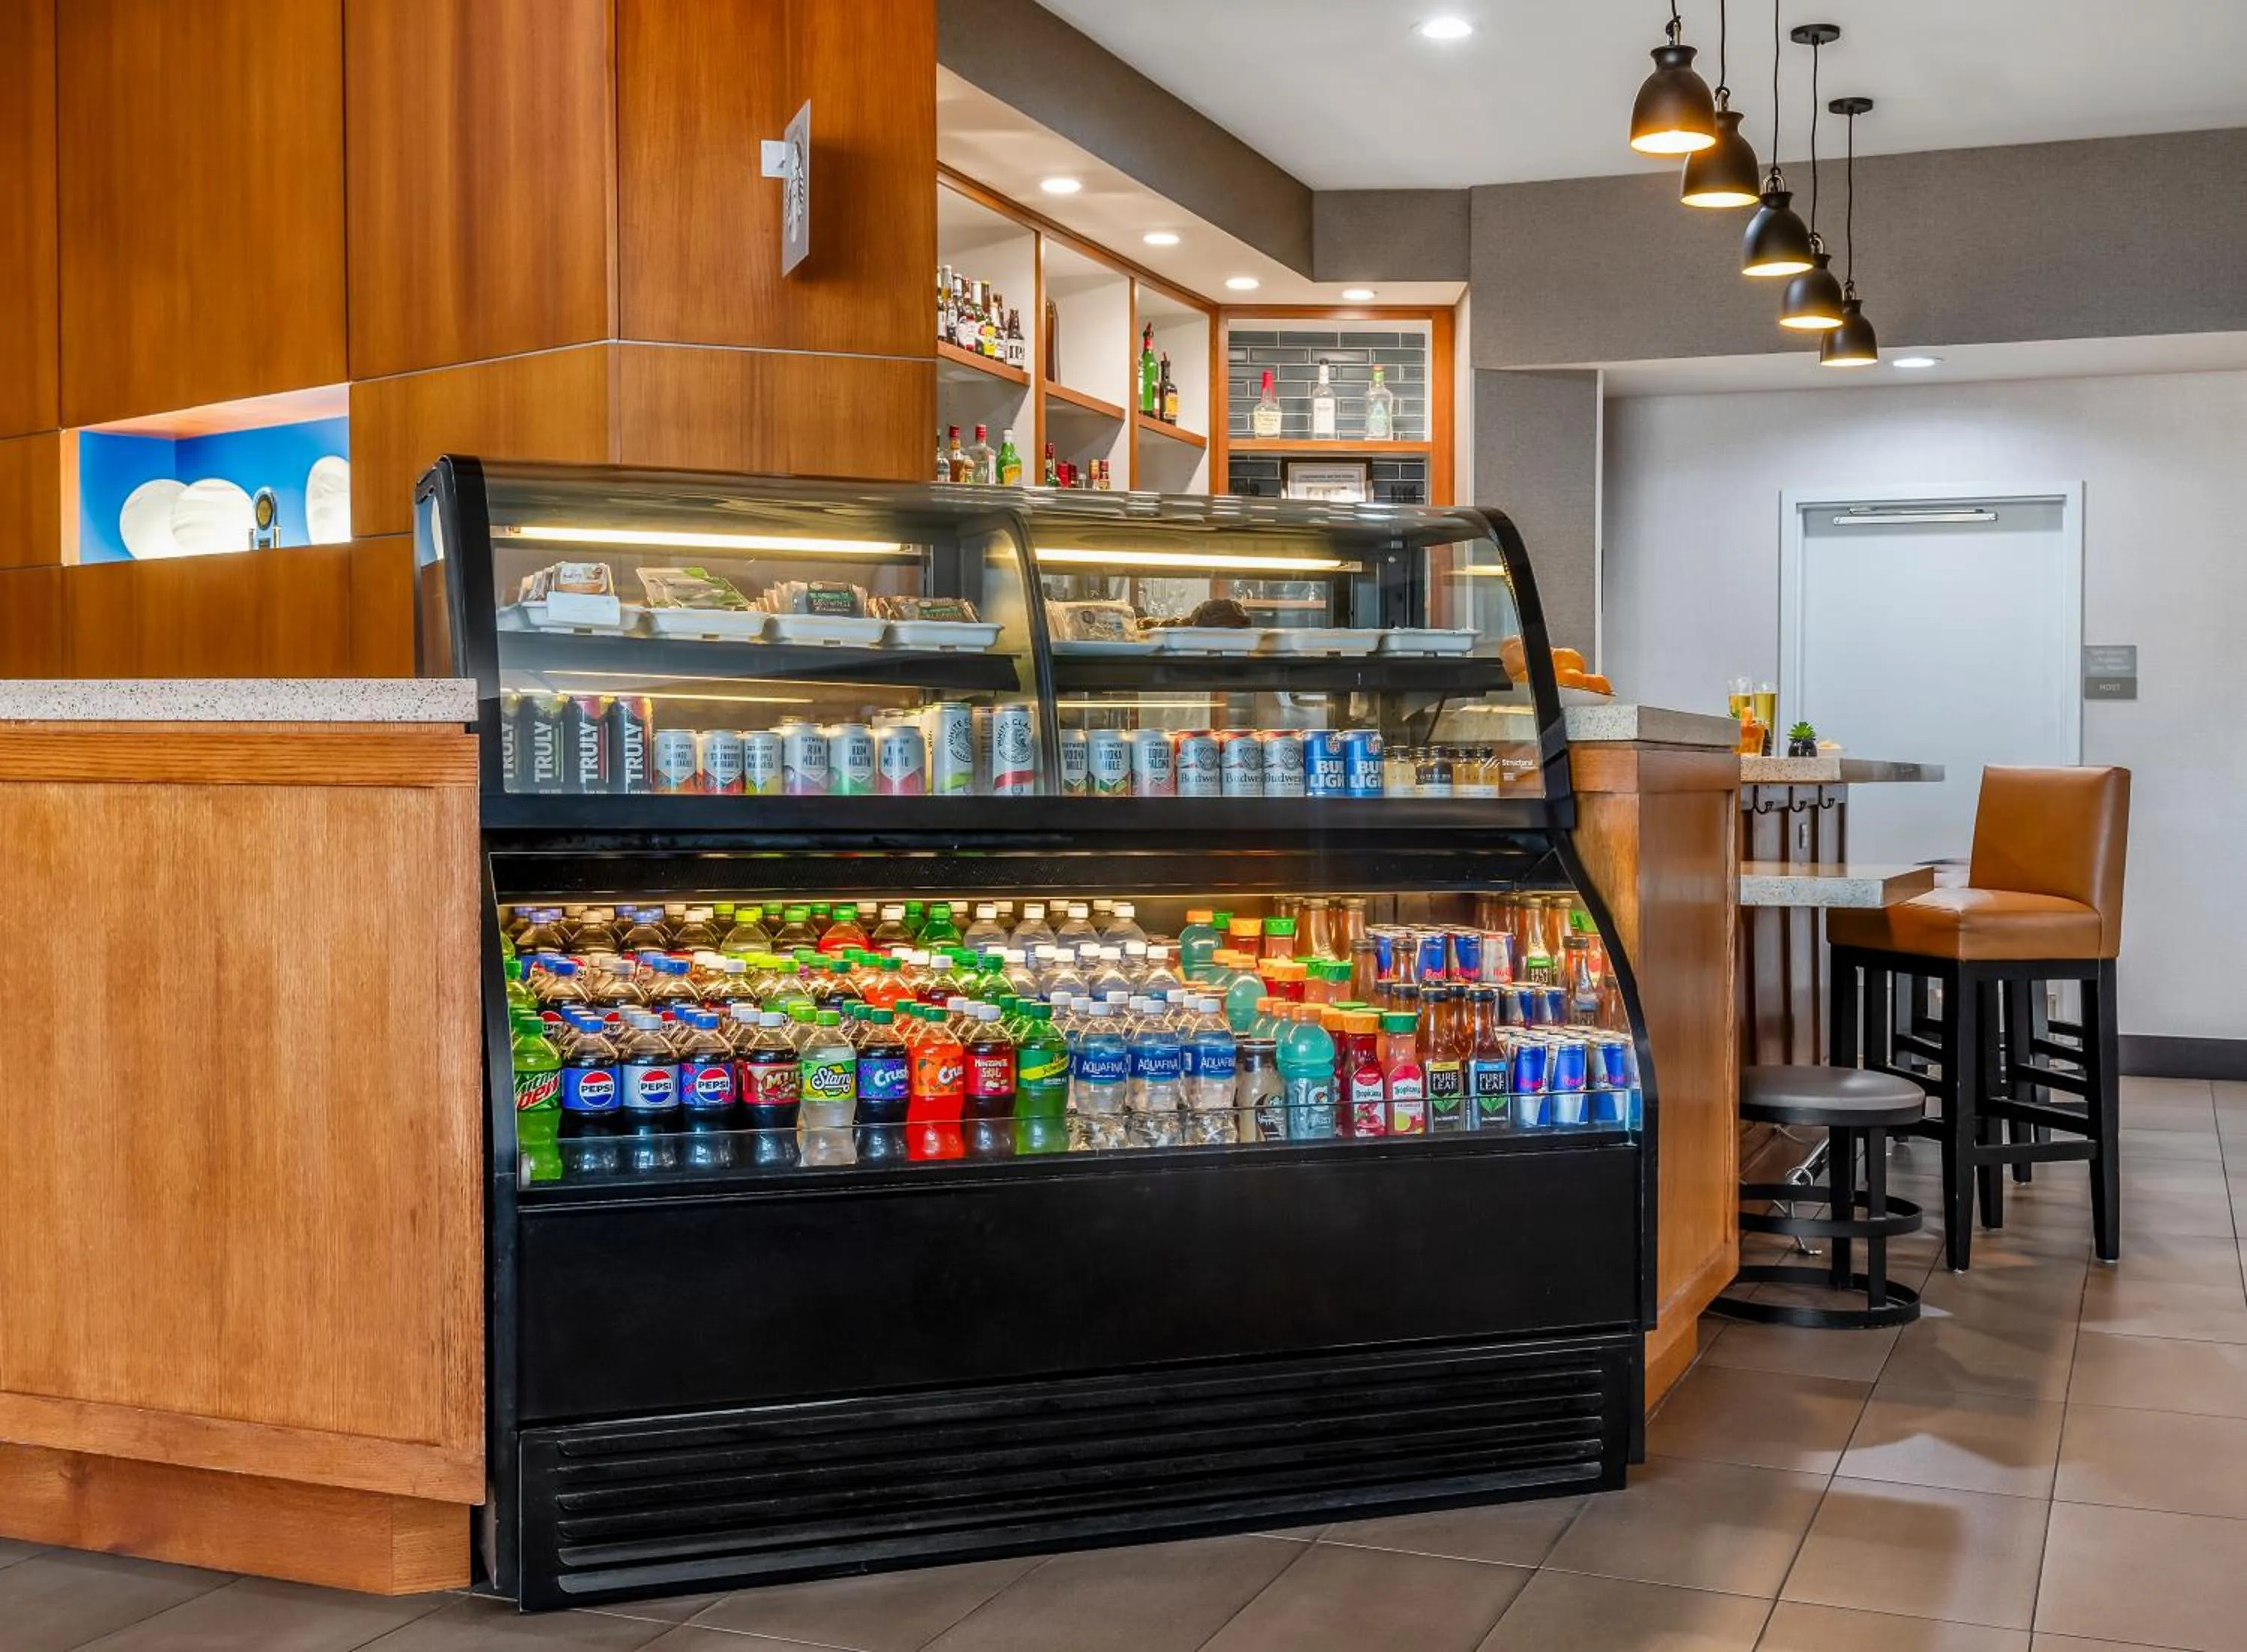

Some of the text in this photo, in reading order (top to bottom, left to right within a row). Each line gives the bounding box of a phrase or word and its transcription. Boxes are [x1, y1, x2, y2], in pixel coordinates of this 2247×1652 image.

[534, 721, 553, 783] TRULY
[580, 721, 598, 783] TRULY
[624, 721, 643, 783] TRULY
[1433, 1072, 1458, 1083] PURE
[1479, 1072, 1505, 1082] PURE
[580, 1084, 613, 1093] PEPSI
[640, 1082, 672, 1090] PEPSI
[697, 1080, 729, 1089] PEPSI
[1433, 1081, 1457, 1091] LEAF
[1479, 1081, 1505, 1091] LEAF
